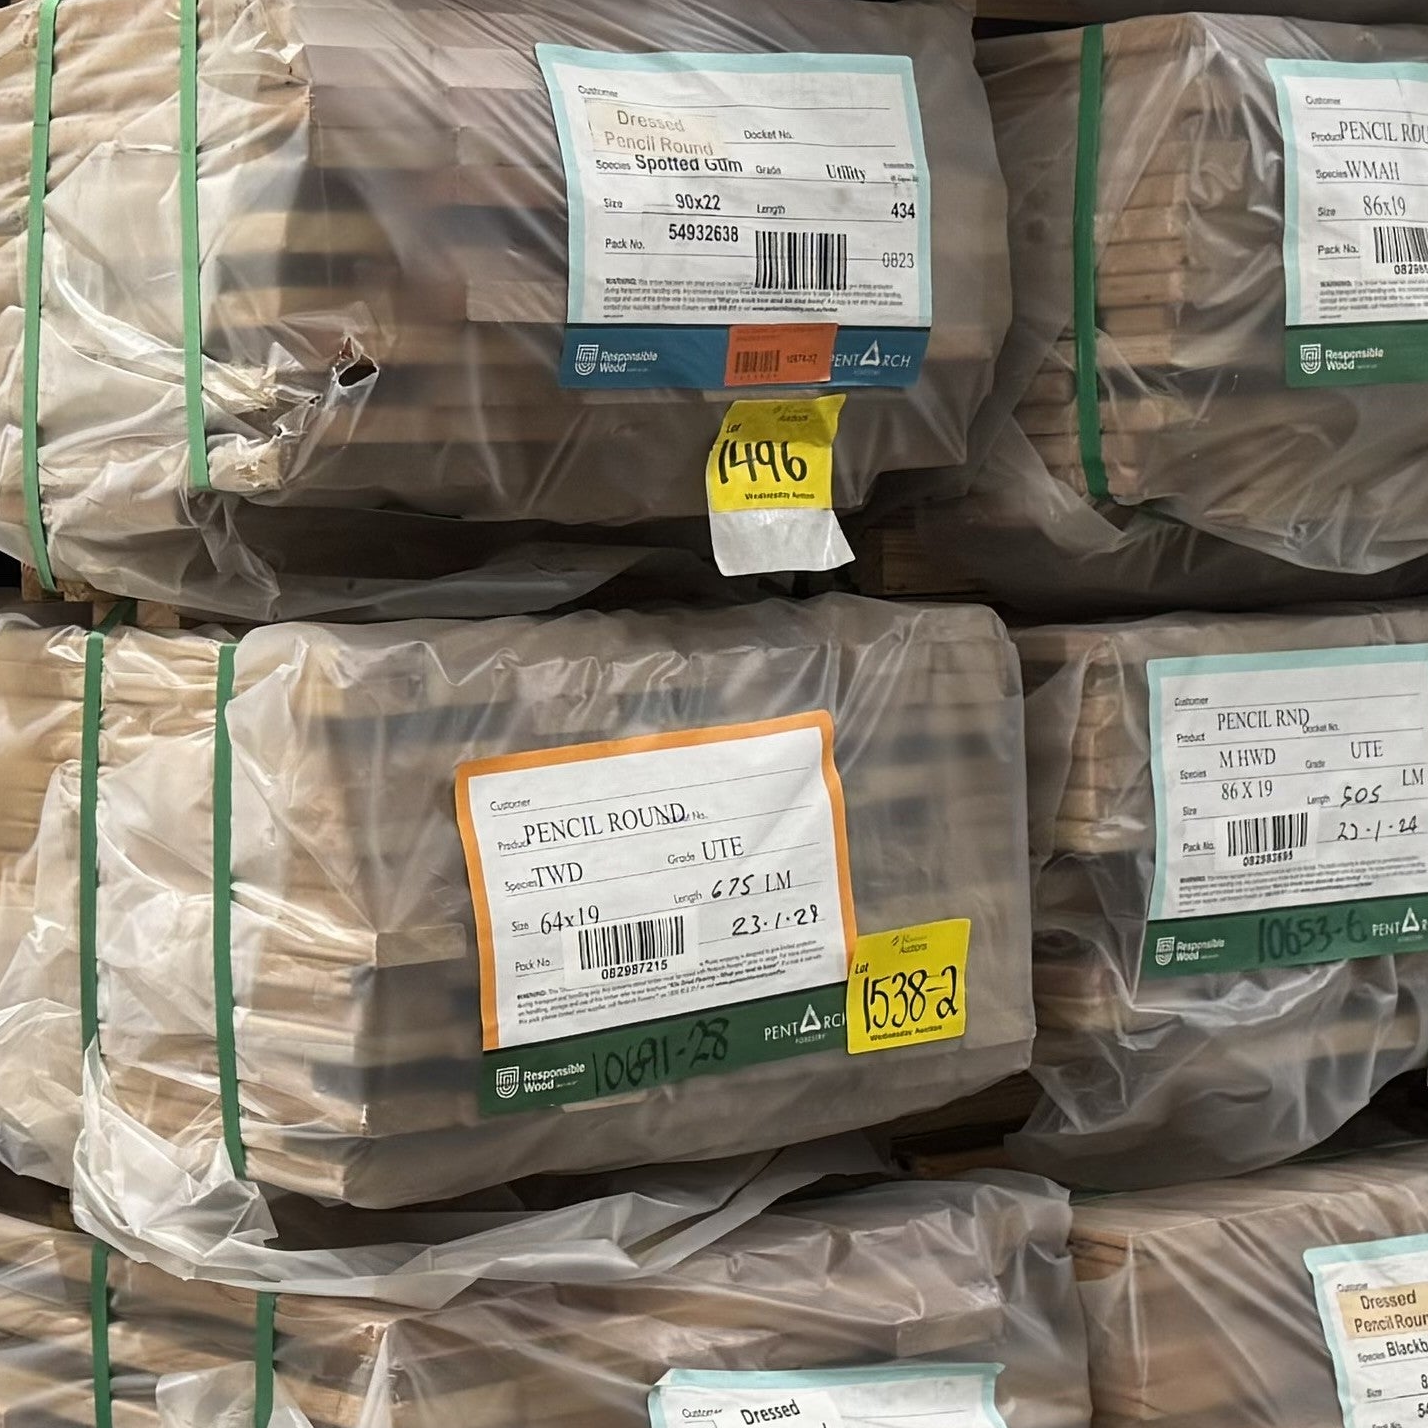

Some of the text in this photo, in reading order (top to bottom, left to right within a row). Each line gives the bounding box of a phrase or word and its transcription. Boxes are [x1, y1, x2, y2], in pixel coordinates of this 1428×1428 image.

[617, 110, 685, 133] Dressed
[1339, 120, 1398, 142] PENCIL
[605, 131, 713, 156] Pencil Round
[635, 155, 867, 183] Spotted Utility
[1345, 160, 1400, 181] WMAH
[675, 193, 916, 219] 90x22 434
[1363, 194, 1407, 217] 86x19
[669, 224, 739, 243] 54932638
[882, 252, 914, 268] 0823
[600, 351, 658, 363] Responsible
[600, 361, 627, 373] Wood
[1325, 359, 1355, 371] Wood
[718, 440, 808, 484] 1496
[1174, 695, 1209, 707] Customer
[1177, 708, 1310, 744] Product PENCIL RND
[1219, 741, 1383, 768] M HWD UTE
[1402, 768, 1424, 786] LM
[1221, 780, 1273, 799] 86 X 19
[524, 801, 687, 846] PENCIL ROUND
[532, 836, 745, 888] TWD UTE
[710, 873, 755, 899] 675
[765, 870, 793, 893] LM
[540, 904, 601, 935] 64x19
[601, 958, 669, 980] 082987215
[854, 961, 871, 975] Lot
[862, 966, 959, 1035] 1538-2
[524, 1062, 586, 1083] Responsible
[524, 1079, 555, 1093] Wood
[1360, 1290, 1417, 1310] Dressed
[1354, 1314, 1395, 1333] Pencil
[741, 1399, 801, 1426] Dressed
